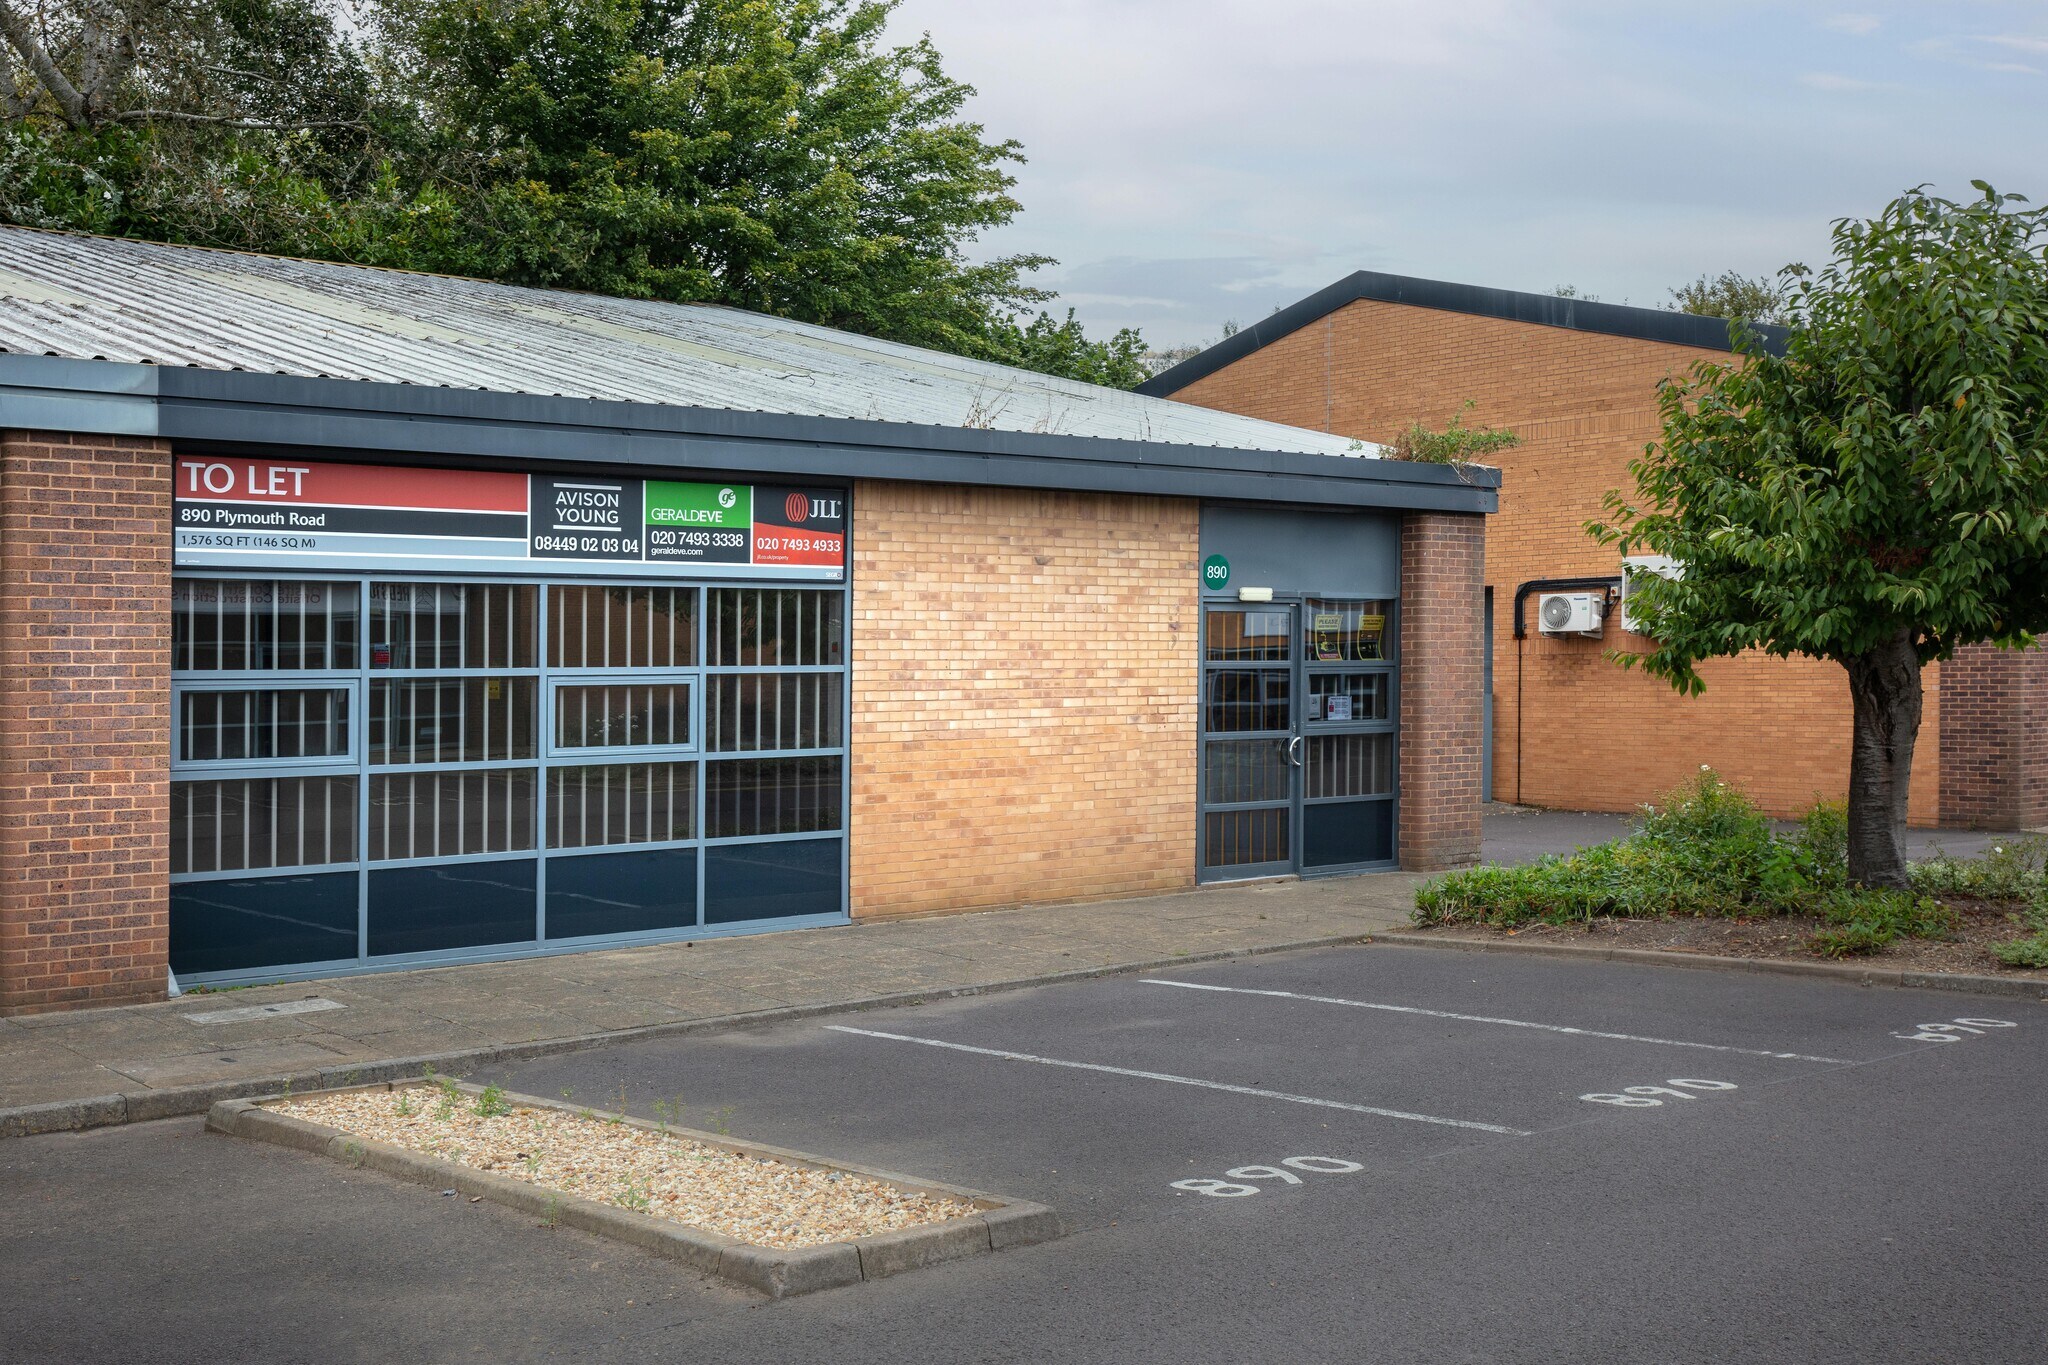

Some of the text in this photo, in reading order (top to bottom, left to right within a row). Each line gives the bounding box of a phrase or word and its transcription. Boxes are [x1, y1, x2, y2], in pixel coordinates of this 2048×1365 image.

[182, 462, 310, 496] TO LET
[555, 491, 619, 507] AVISON
[181, 508, 326, 526] 890 Plymouth Road
[556, 508, 619, 524] YOUNG
[651, 508, 723, 523] GERALDEVE
[809, 499, 841, 519] JLL
[181, 535, 316, 548] 1,576 SQ FT (146 SQ M)
[535, 536, 639, 553] 08449 02 03 04
[651, 531, 744, 547] 020 7493 3338
[757, 537, 841, 552] 020 7493 4933
[651, 547, 703, 556] geraldeve.com
[1206, 564, 1228, 579] 890
[1579, 1079, 1739, 1107] 890
[1170, 1156, 1365, 1197] 890
